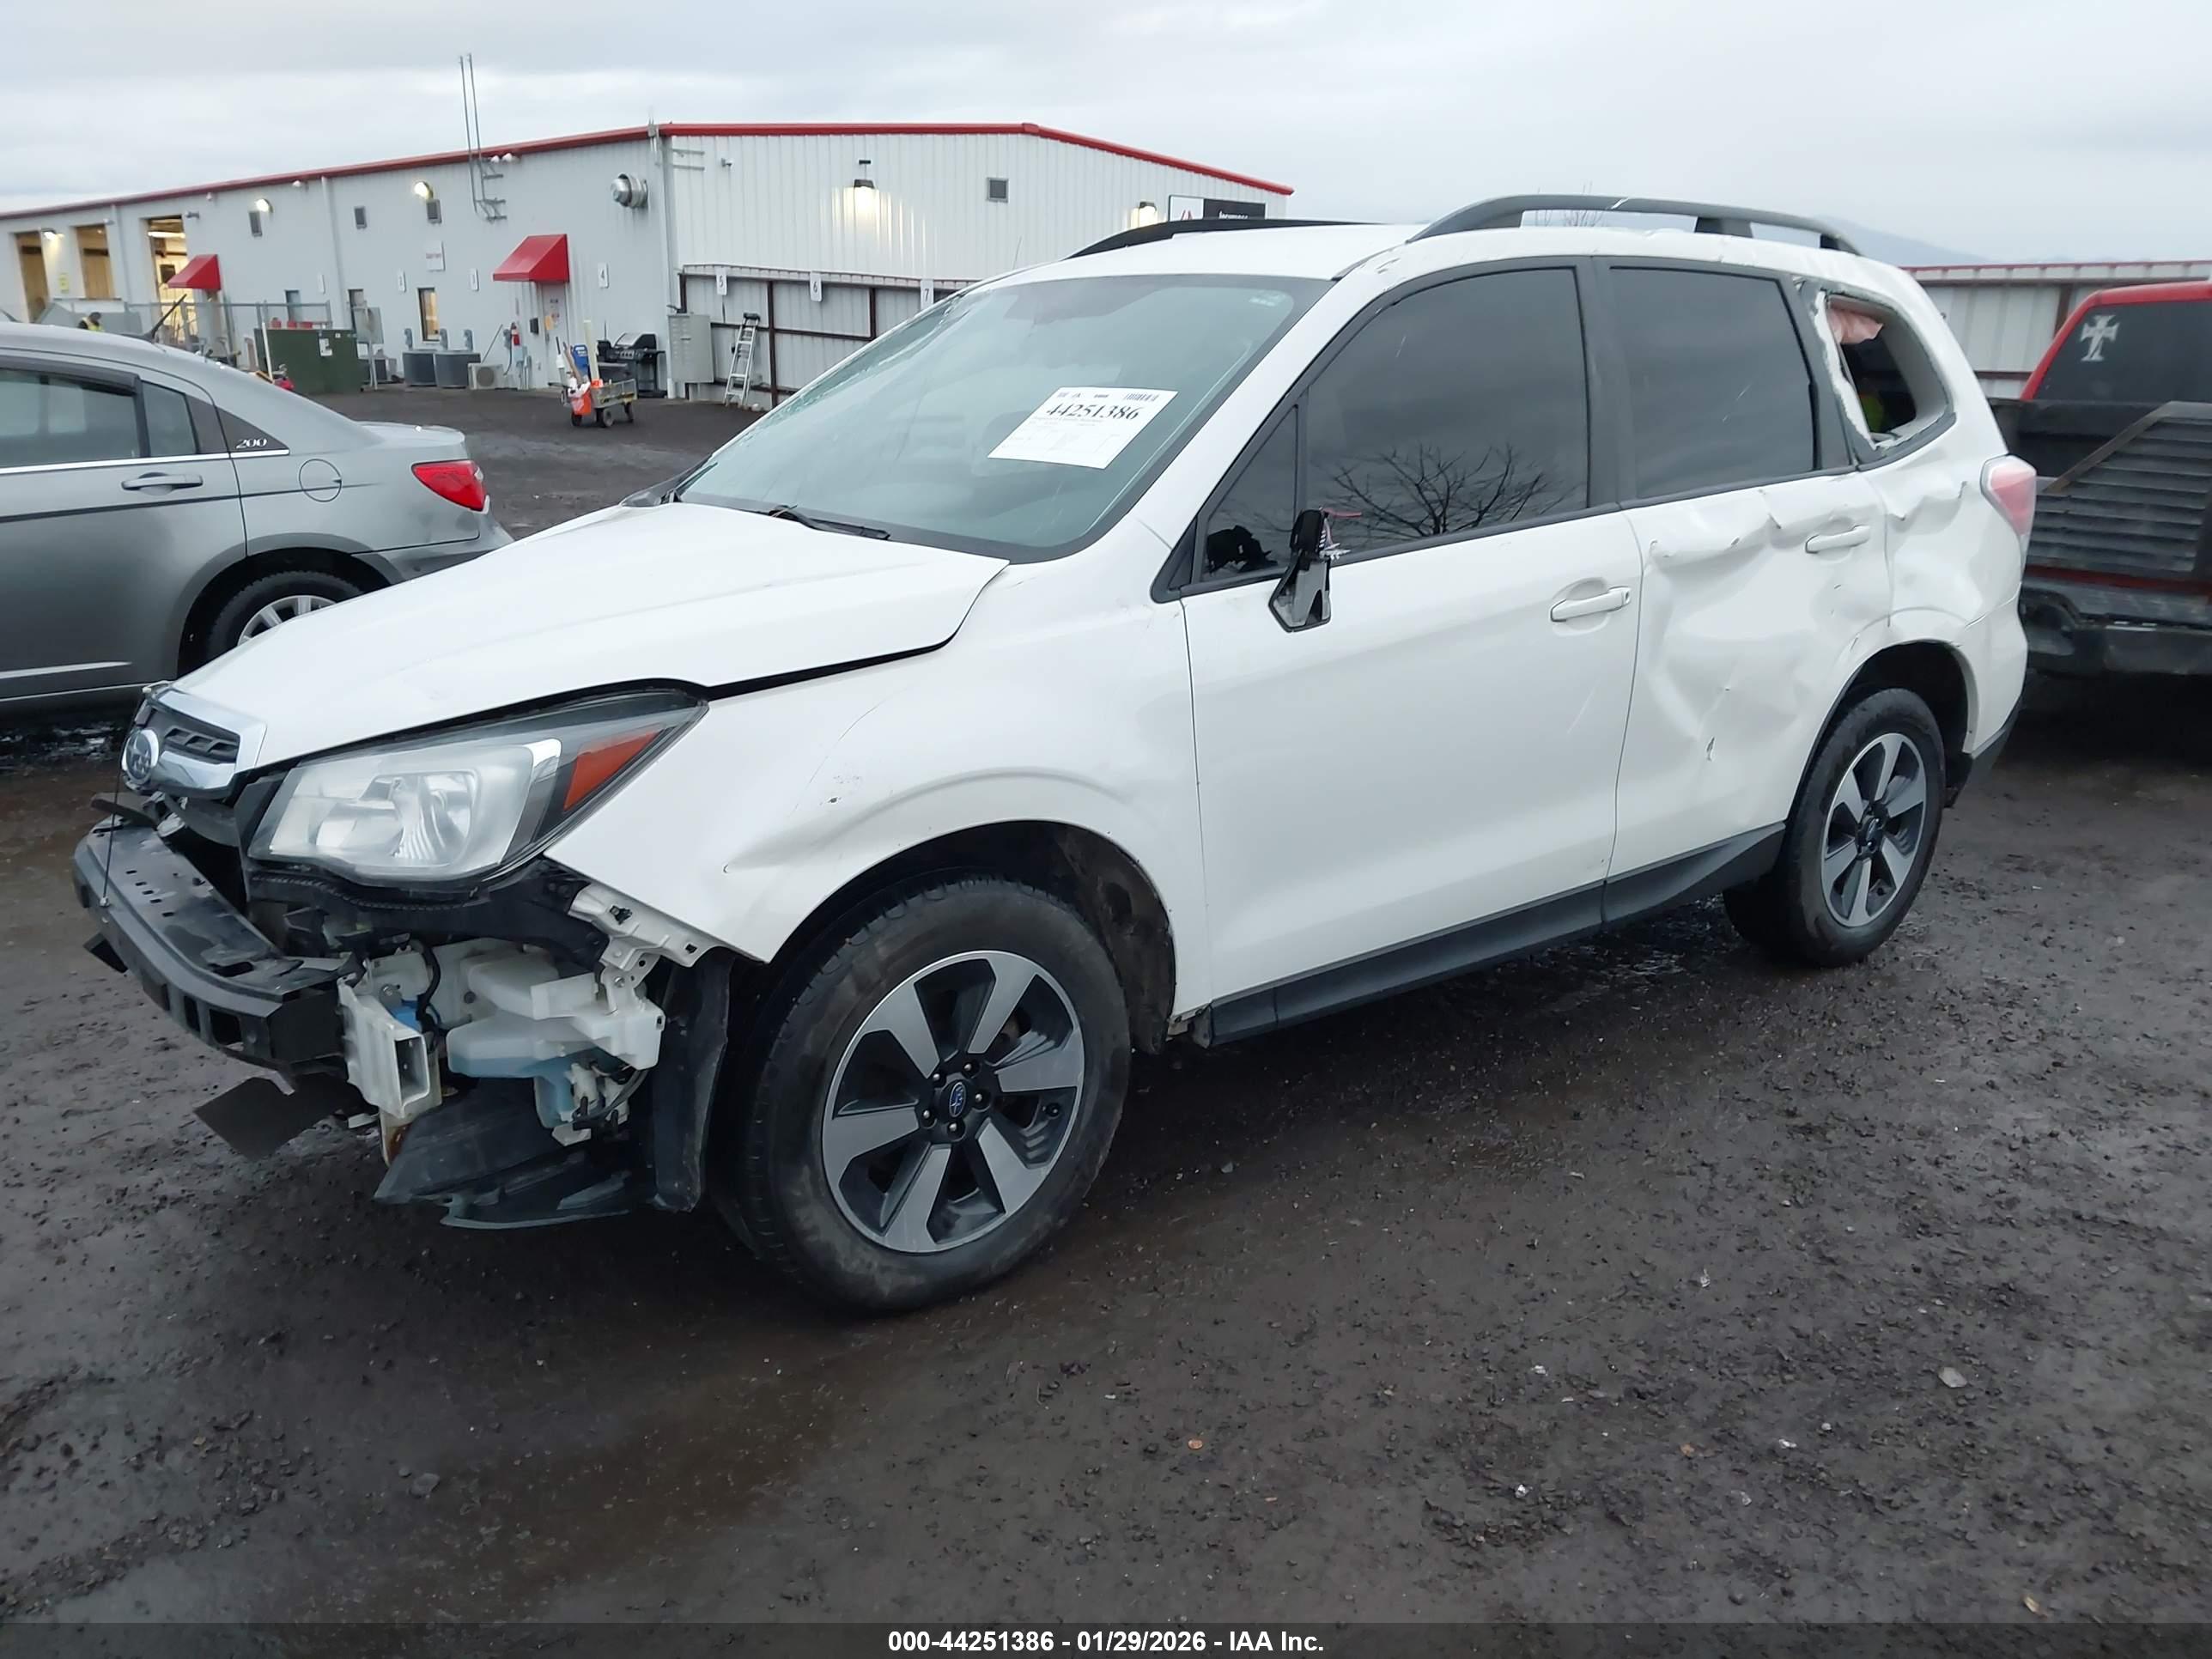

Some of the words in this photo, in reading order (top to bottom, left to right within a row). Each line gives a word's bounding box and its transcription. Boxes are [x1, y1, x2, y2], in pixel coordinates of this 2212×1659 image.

[719, 274, 725, 288] 5
[812, 282, 818, 294] 6
[924, 288, 930, 301] 7
[1046, 403, 1143, 420] 44251386
[235, 438, 268, 449] 200
